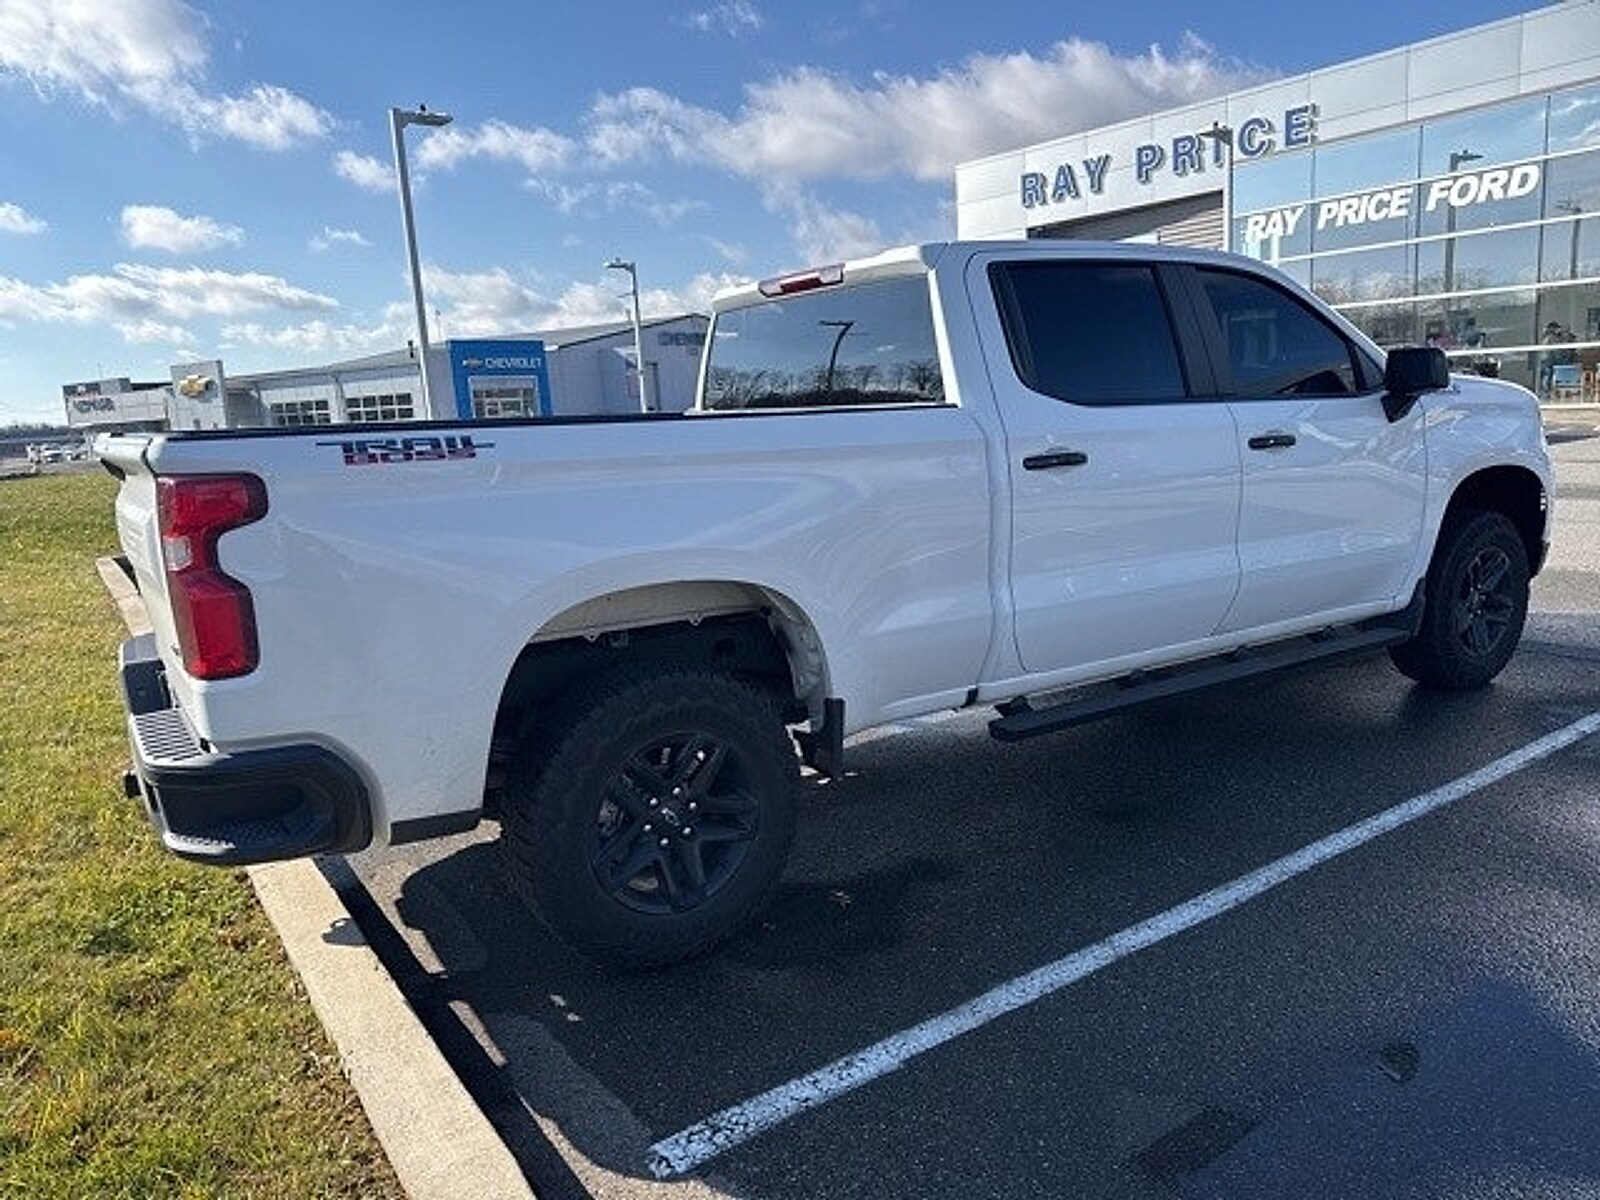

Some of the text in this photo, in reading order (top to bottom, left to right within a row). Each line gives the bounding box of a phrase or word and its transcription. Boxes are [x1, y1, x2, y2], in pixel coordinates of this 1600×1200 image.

[1020, 102, 1320, 208] RAY PRICE
[1245, 164, 1540, 242] RAY PRICE FORD
